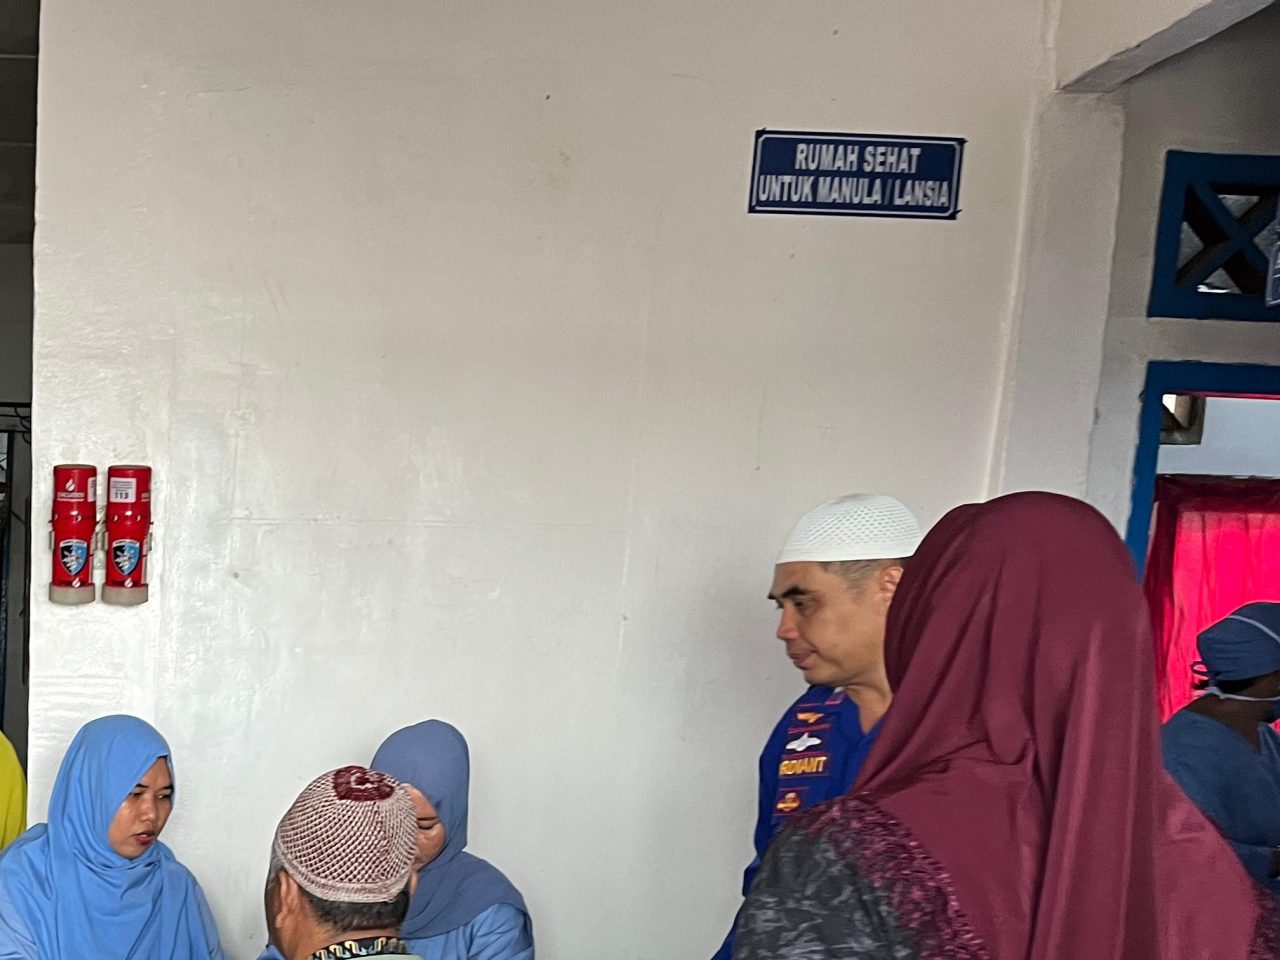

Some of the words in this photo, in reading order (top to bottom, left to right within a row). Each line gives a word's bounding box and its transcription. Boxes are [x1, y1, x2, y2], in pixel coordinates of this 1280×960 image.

[795, 143, 859, 171] RUMAH
[863, 146, 922, 173] SEHAT
[759, 175, 816, 202] UNTUK
[816, 176, 882, 205] MANULA
[893, 179, 950, 207] LANSIA
